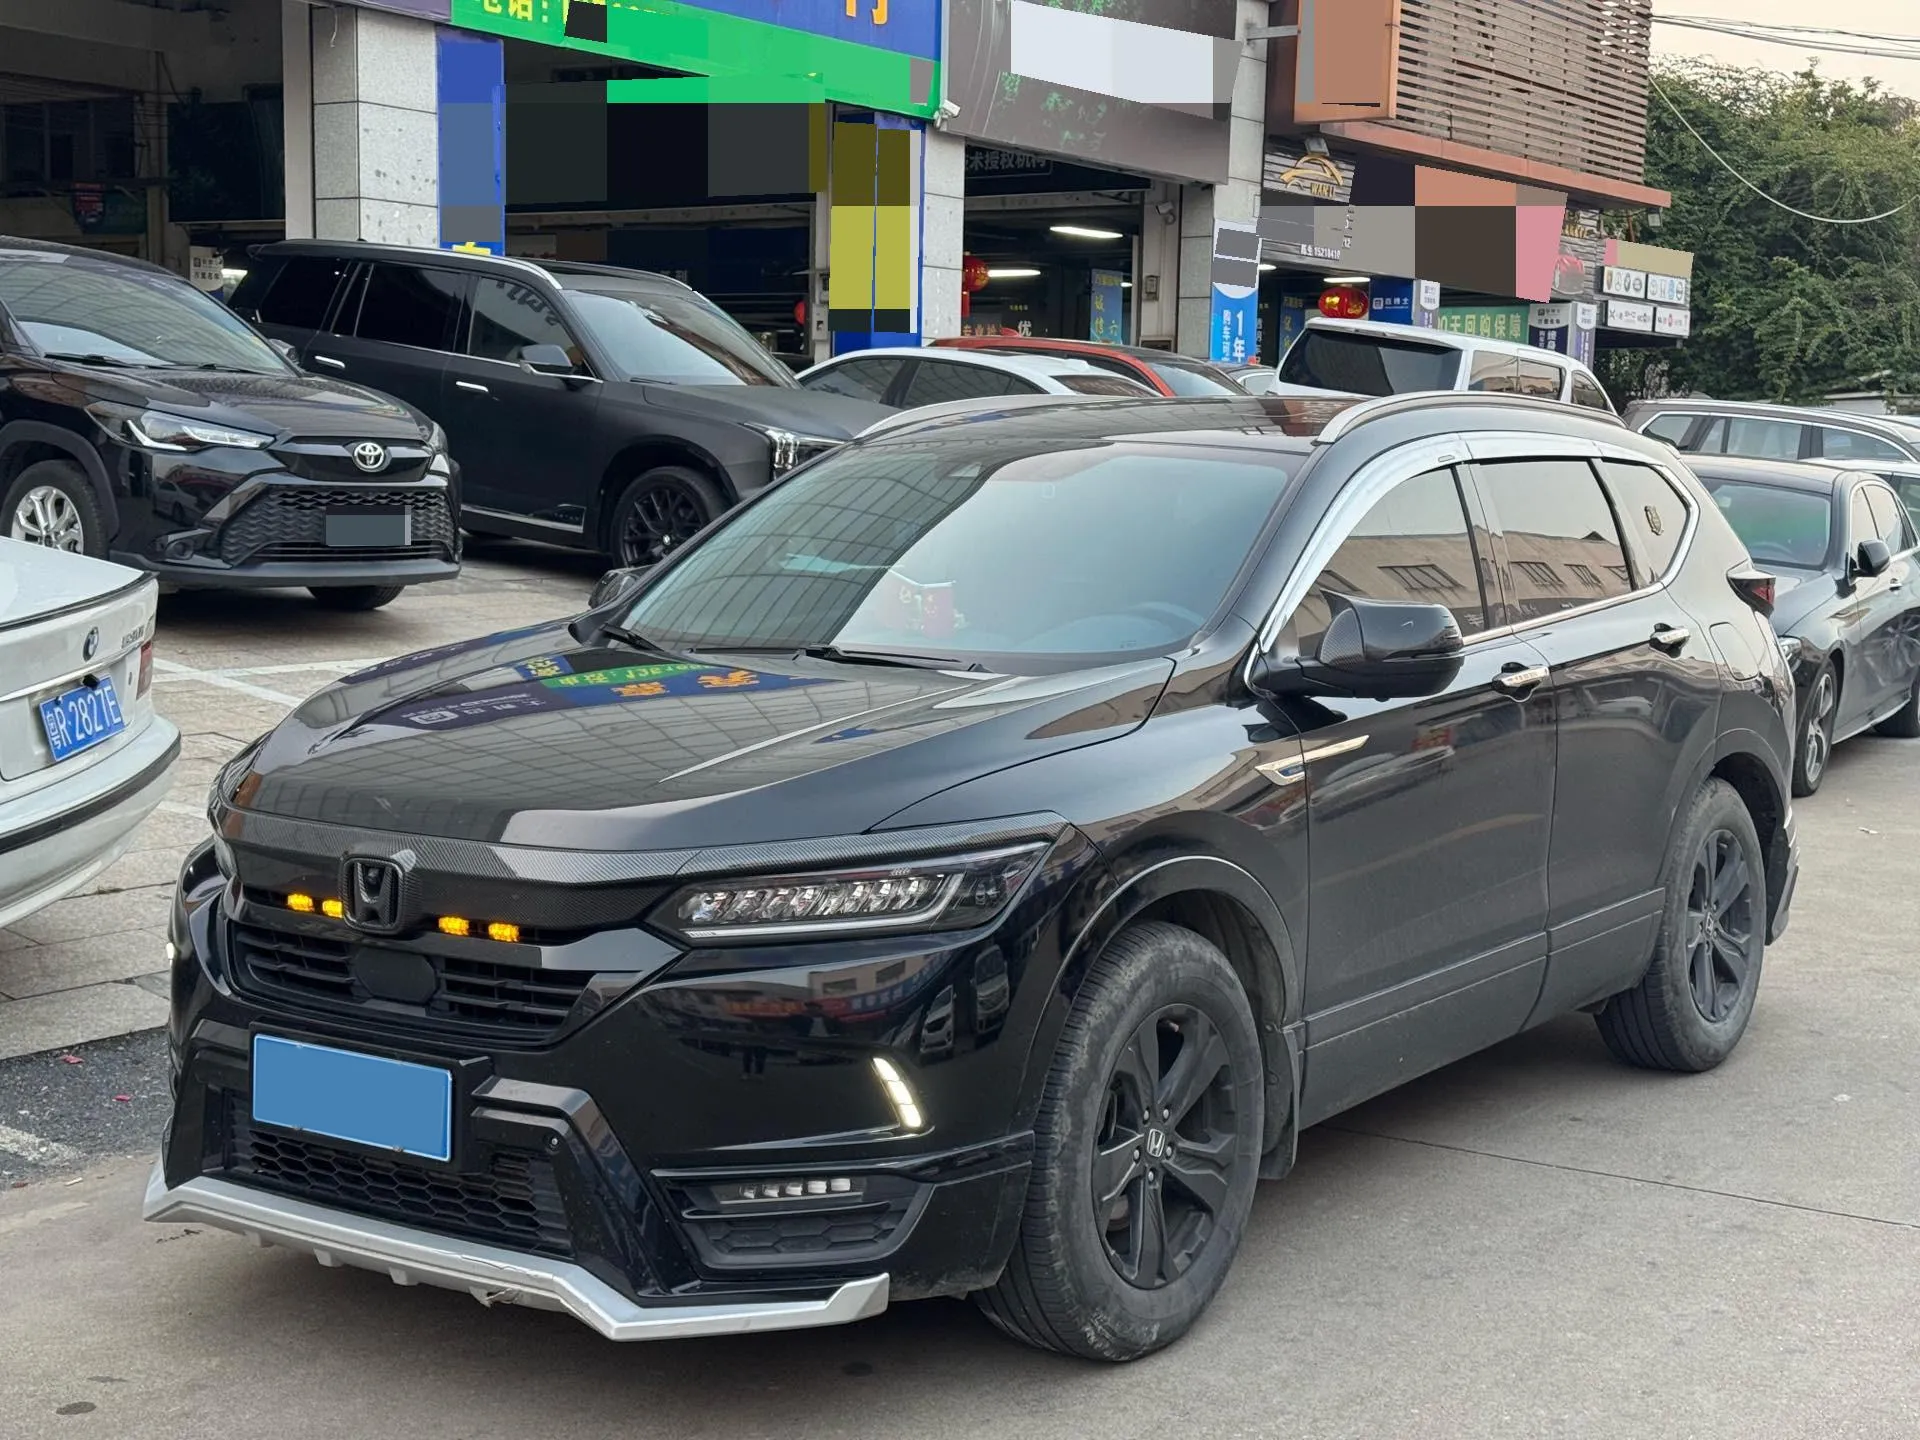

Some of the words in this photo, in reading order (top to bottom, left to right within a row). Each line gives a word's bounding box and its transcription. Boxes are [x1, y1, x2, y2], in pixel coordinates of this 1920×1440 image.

[966, 150, 1046, 170] 术授权机构
[1437, 312, 1522, 339] 0天回购保障
